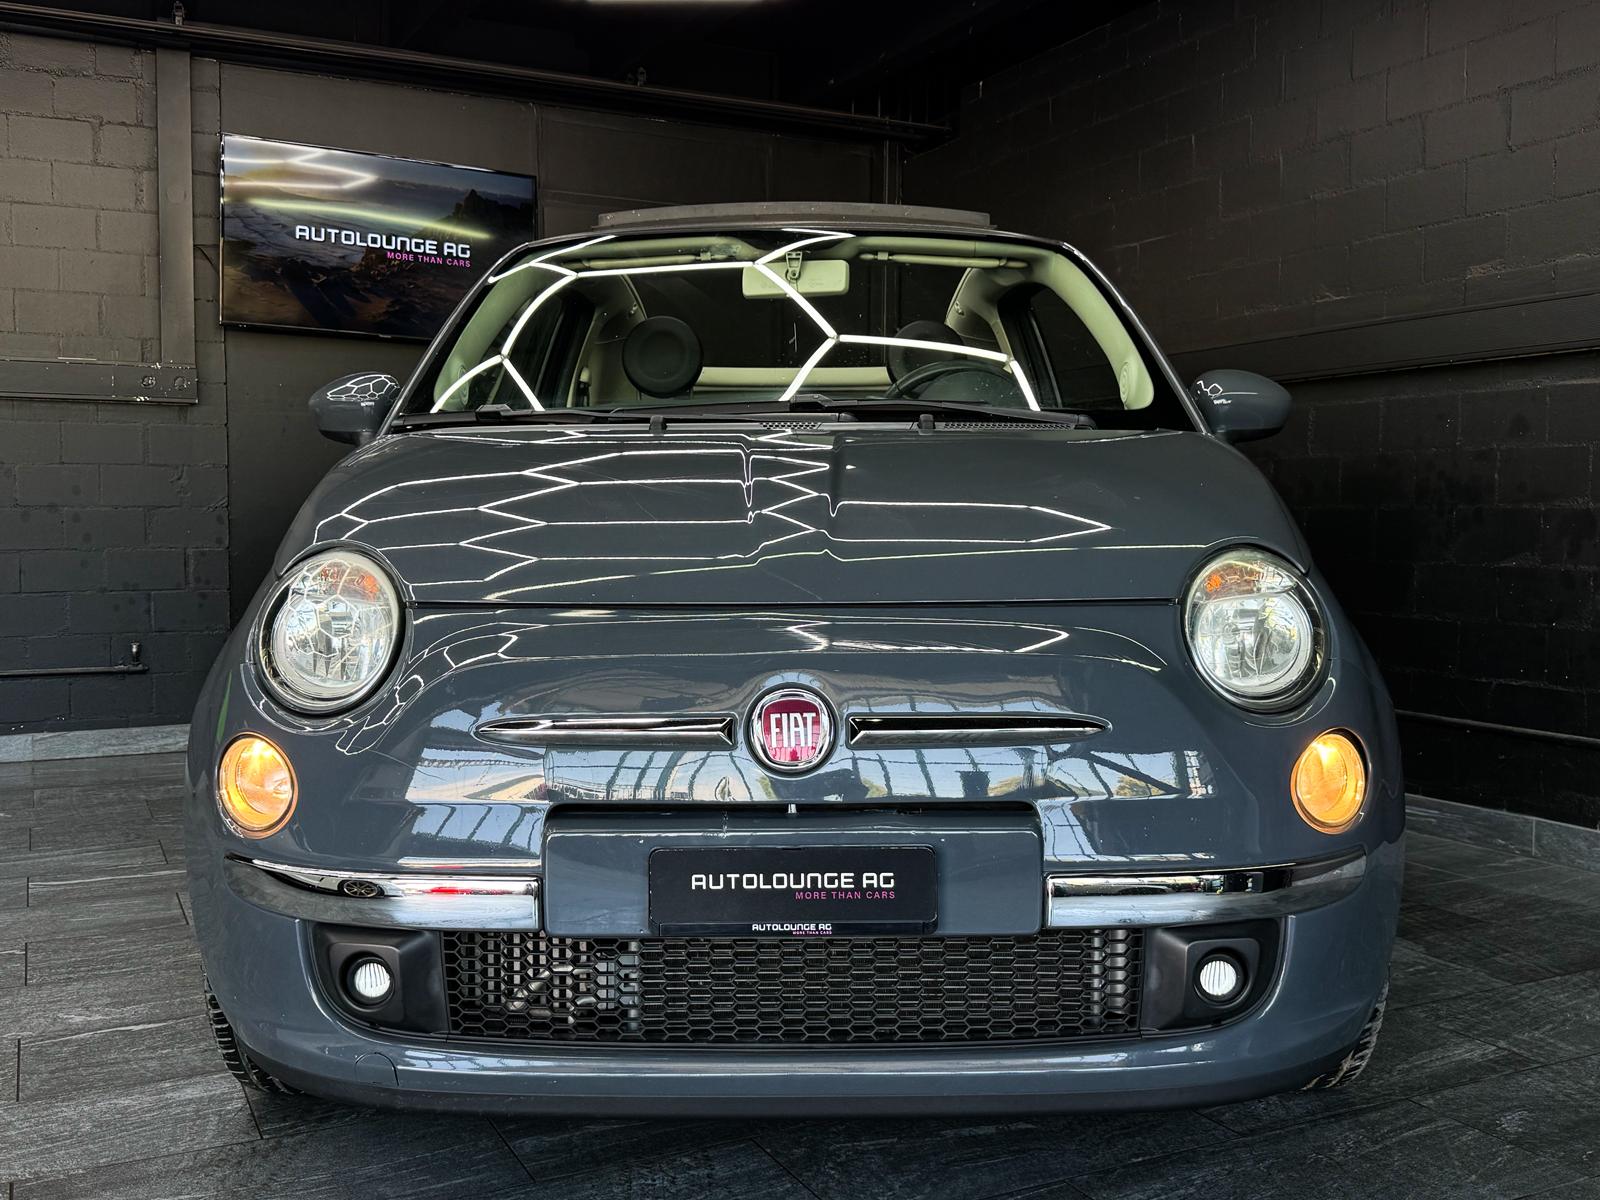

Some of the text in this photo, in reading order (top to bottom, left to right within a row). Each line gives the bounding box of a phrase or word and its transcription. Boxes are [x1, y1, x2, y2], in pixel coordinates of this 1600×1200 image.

[295, 224, 471, 258] AUTOLOUNGE AG
[387, 251, 471, 268] MORE THAN CARS
[770, 712, 816, 748] FIAT
[691, 872, 895, 890] AUTOLOUNGE AG
[795, 891, 896, 900] MORE THAN CARS
[752, 923, 832, 931] AUTOLOUNGE AG
